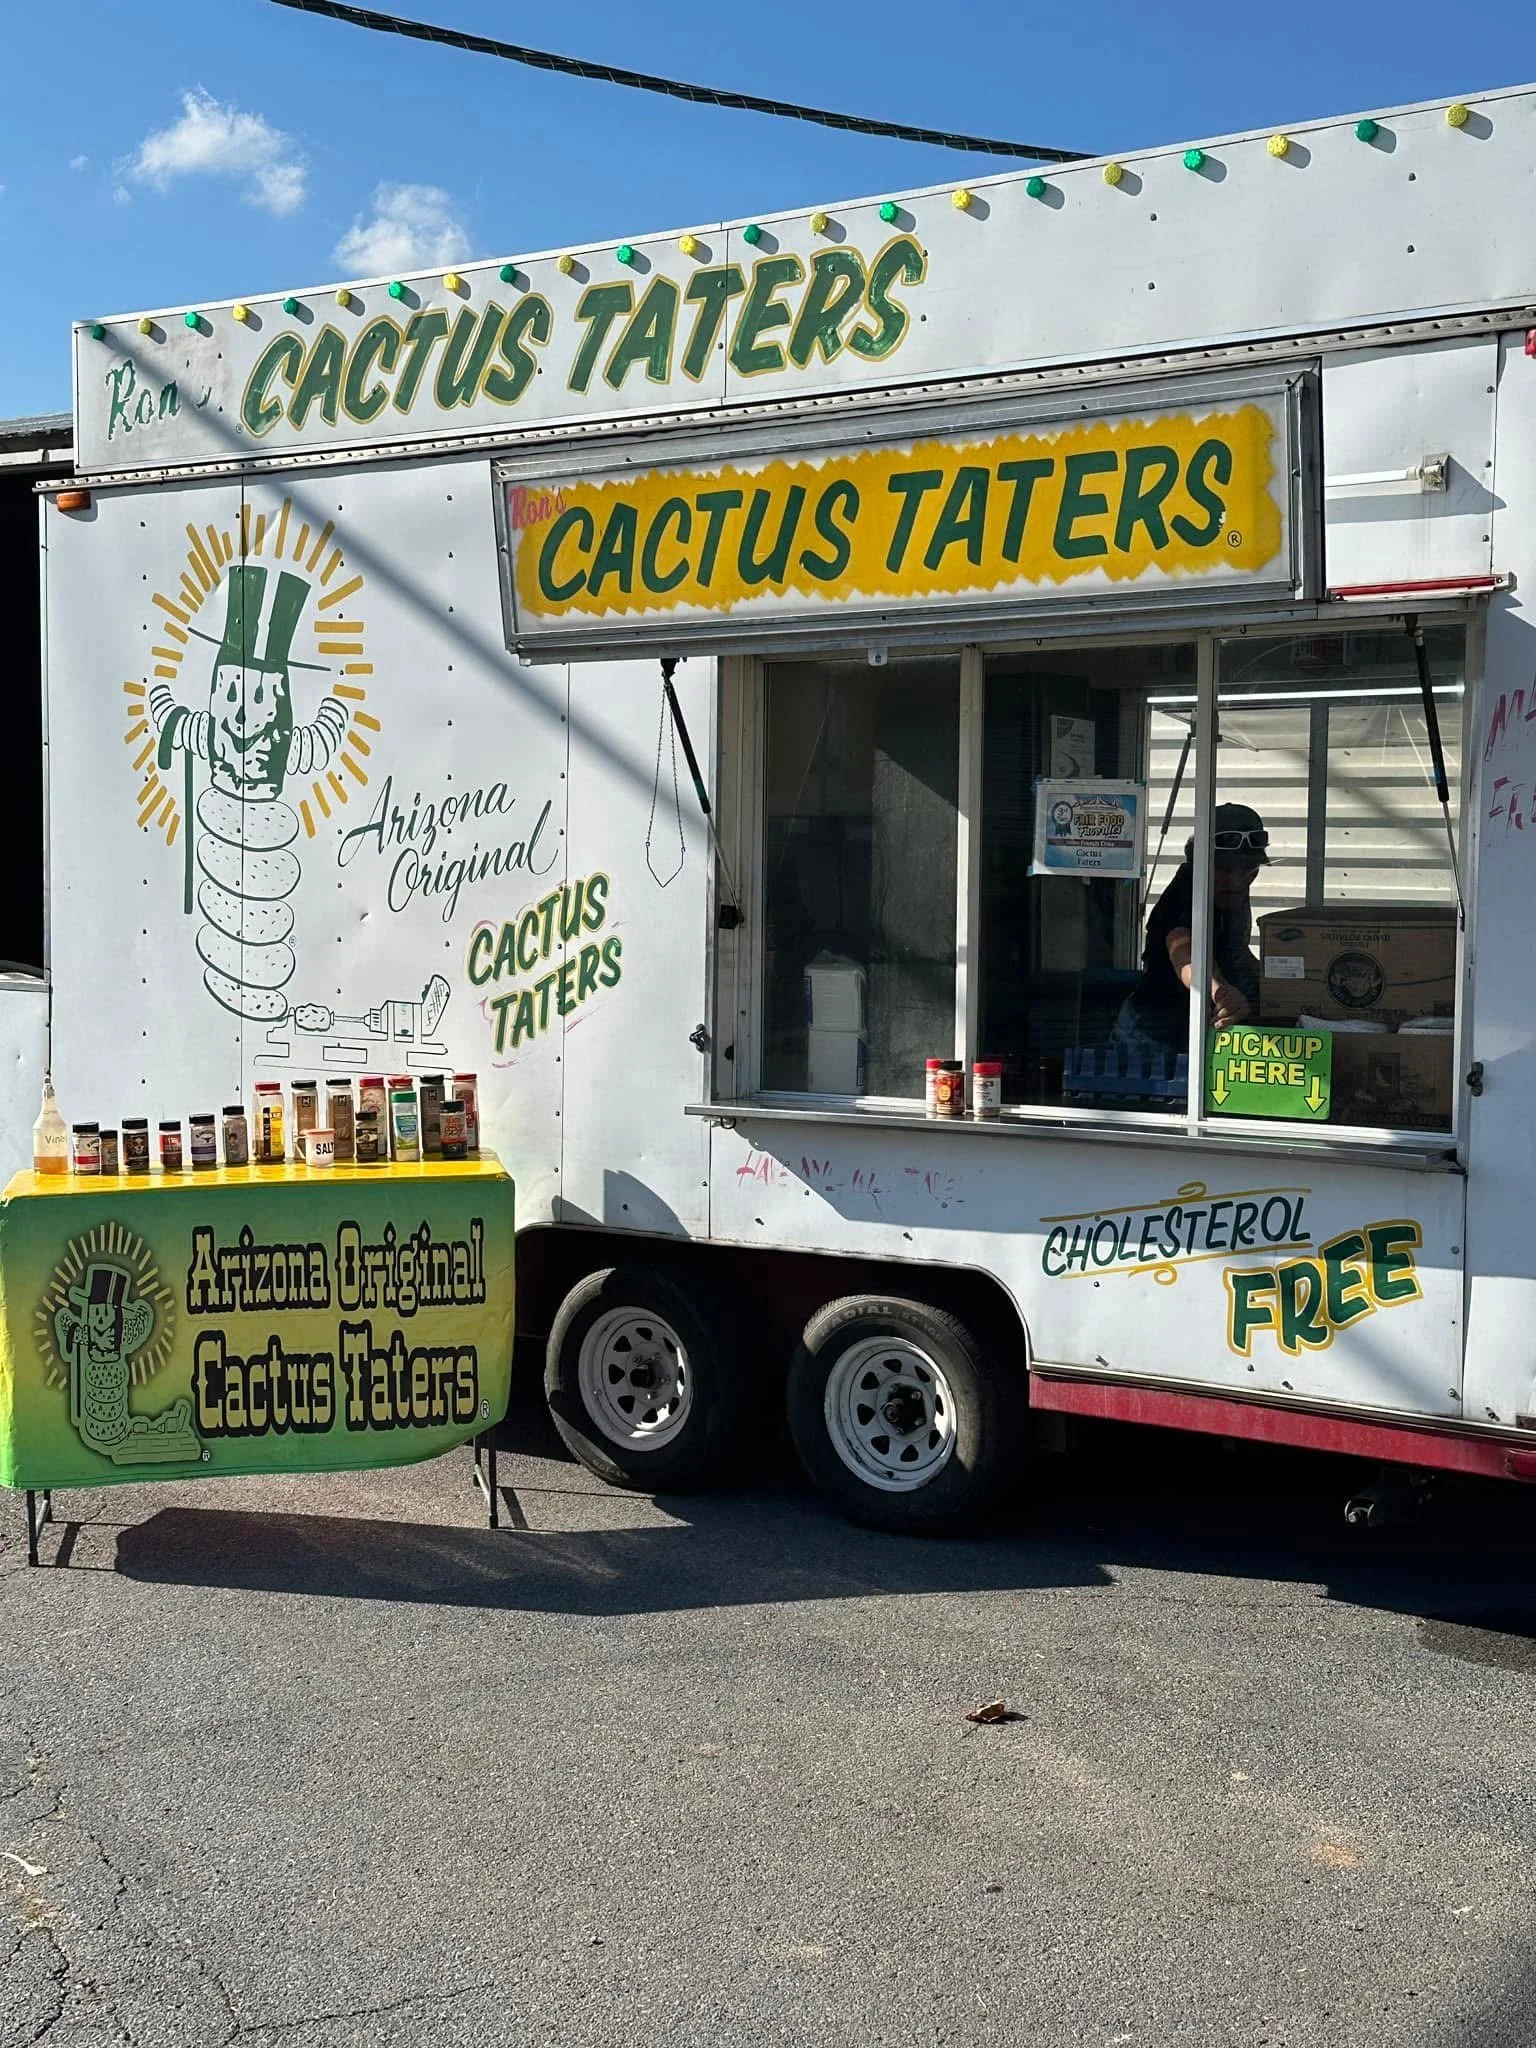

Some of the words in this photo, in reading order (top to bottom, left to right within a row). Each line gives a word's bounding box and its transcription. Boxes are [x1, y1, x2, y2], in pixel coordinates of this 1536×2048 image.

[240, 291, 554, 438] CACTUS
[567, 234, 928, 394] TATERS
[508, 484, 566, 530] Ron's
[538, 477, 860, 602] CACTUS
[886, 438, 1233, 572] TATERS
[337, 775, 516, 867] Arizona
[387, 800, 559, 922] Original
[1098, 814, 1125, 827] FOOD
[468, 872, 610, 987] CACTUS
[490, 936, 623, 1055] TATERS
[1214, 1031, 1324, 1060] PICKUP
[1227, 1057, 1307, 1087] HERE
[186, 1224, 331, 1315] Arizona
[334, 1217, 486, 1318] Original
[1041, 1196, 1312, 1277] CHOLESTEROL
[1222, 1219, 1424, 1357] FREE
[191, 1329, 335, 1437] Cactus
[339, 1319, 480, 1431] Taters
